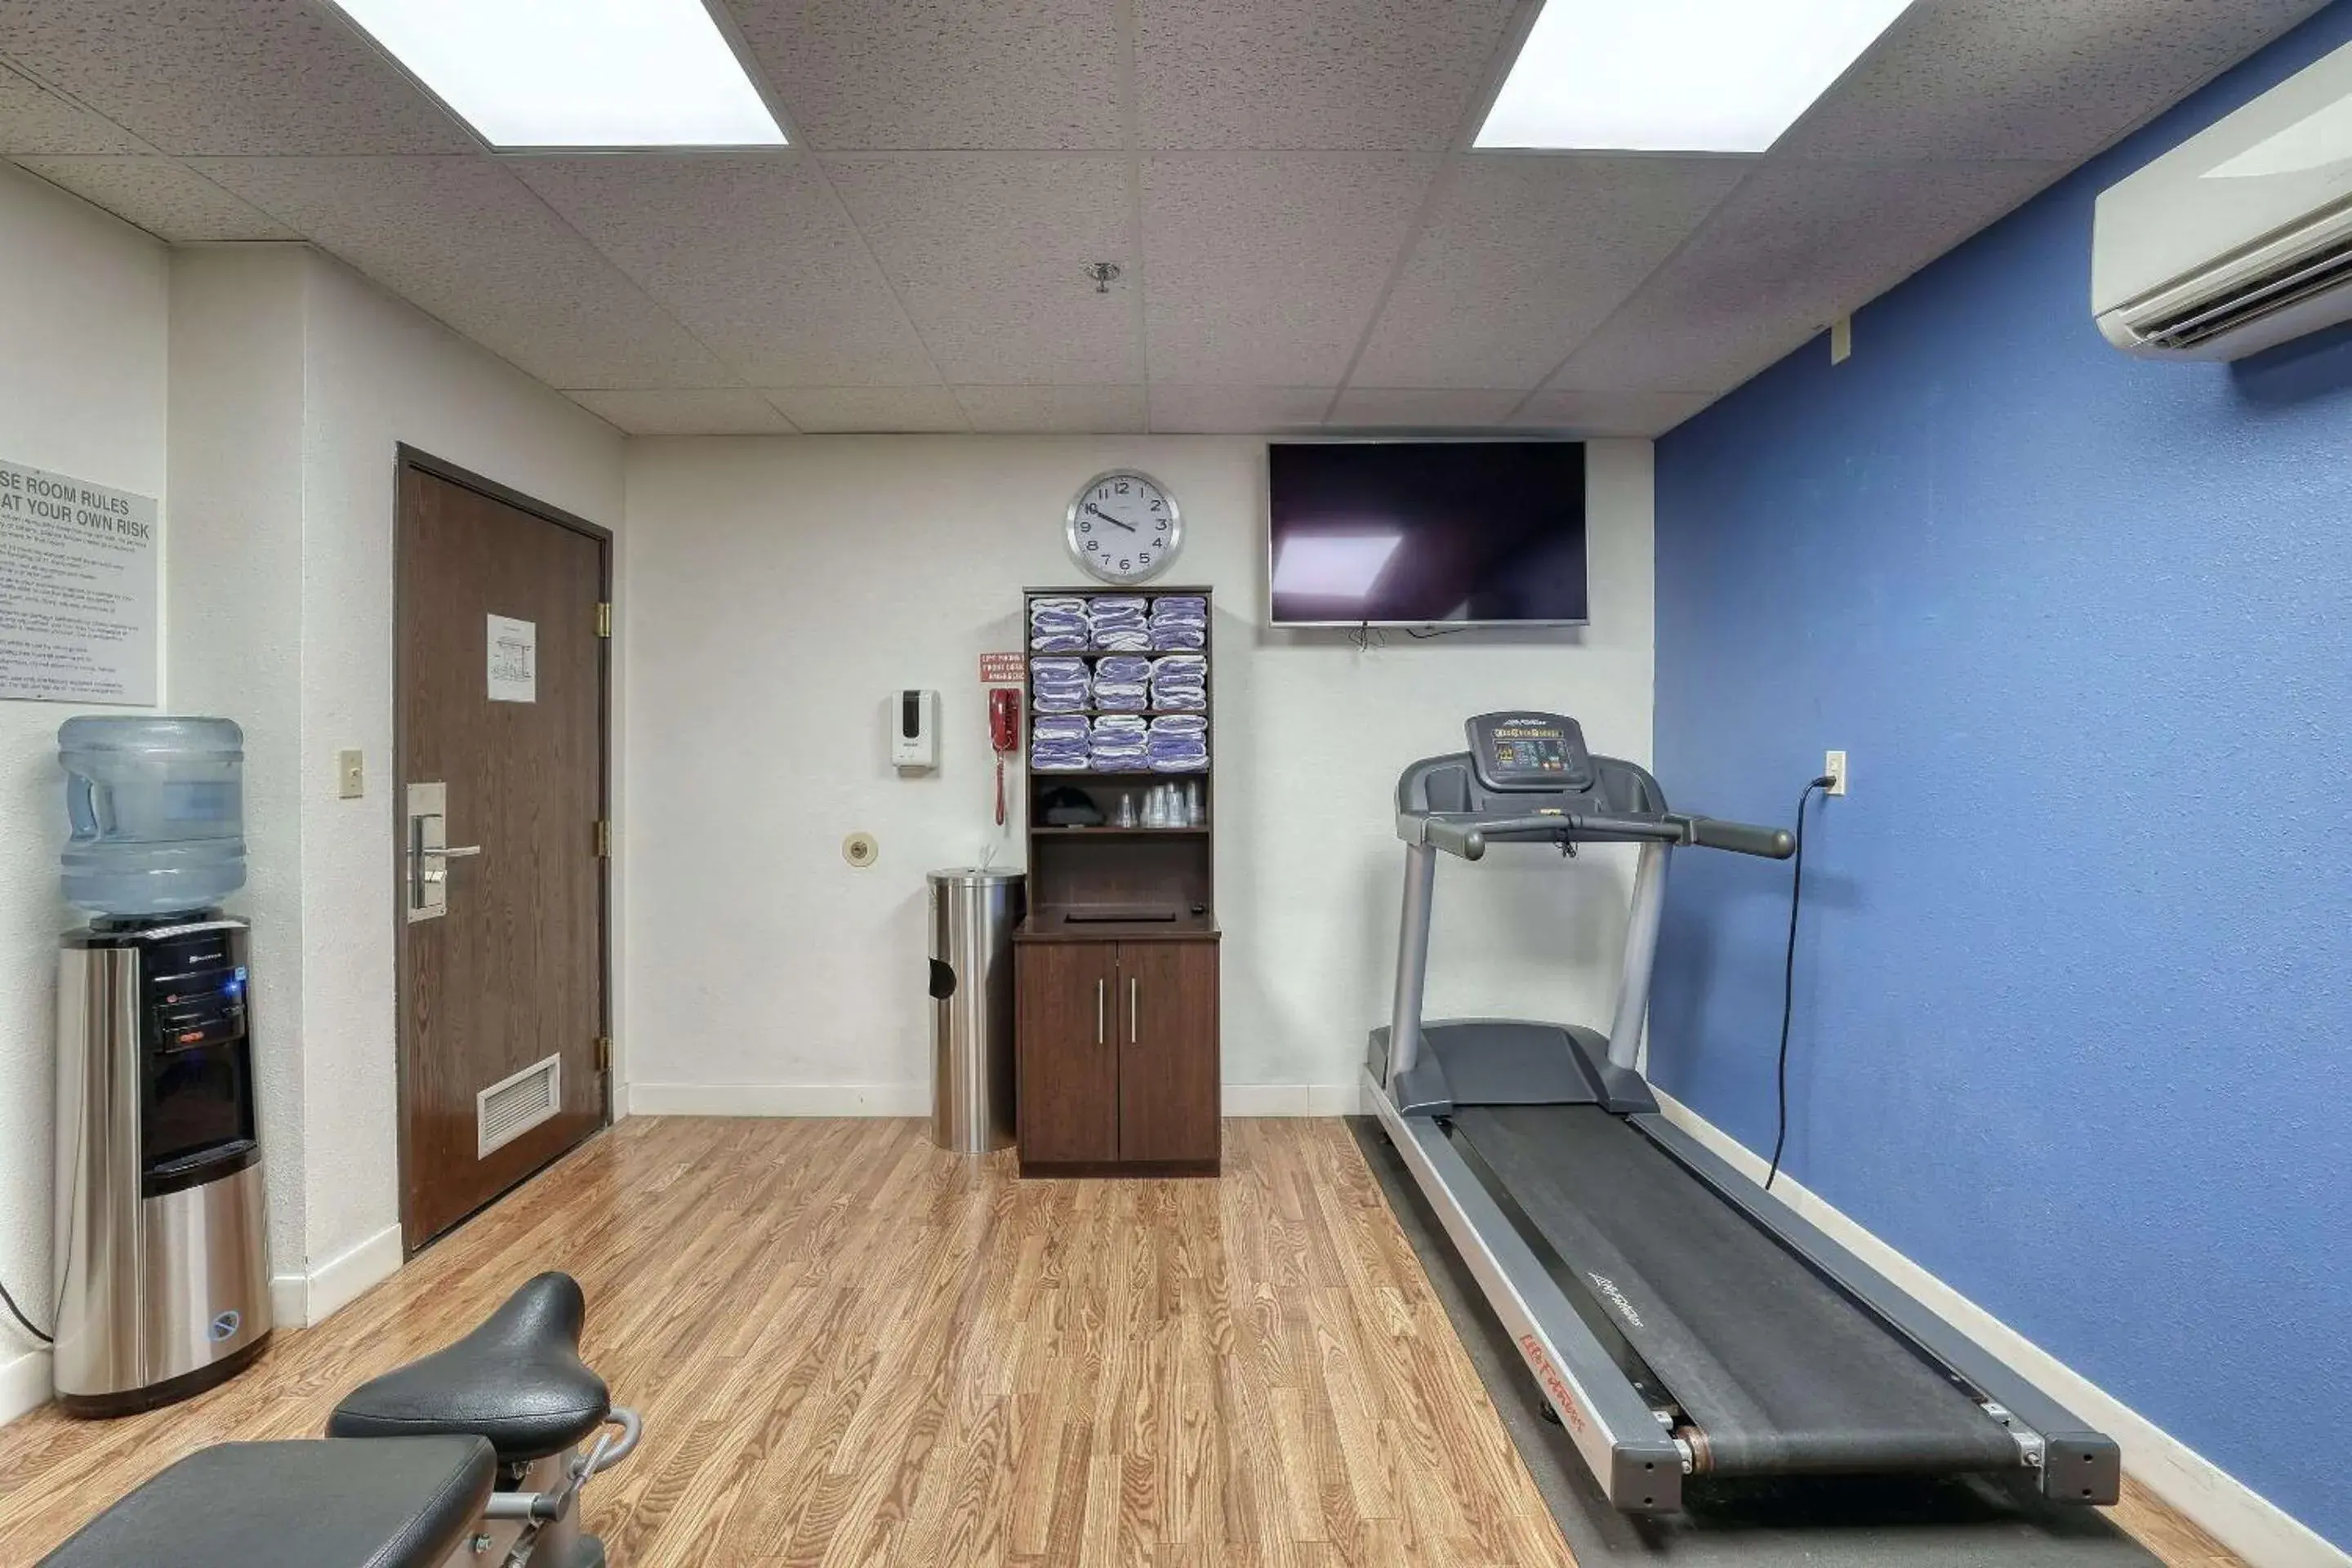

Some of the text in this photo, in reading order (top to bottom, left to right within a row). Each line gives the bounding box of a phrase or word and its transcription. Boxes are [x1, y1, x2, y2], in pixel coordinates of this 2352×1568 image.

[1098, 488, 1108, 500] 11
[1115, 483, 1129, 494] 12
[1140, 488, 1144, 498] 1
[26, 476, 76, 503] ROOM
[81, 490, 129, 515] RULES
[1085, 503, 1098, 514] 10
[1151, 500, 1161, 512] 2
[1, 493, 23, 511] AT
[27, 498, 72, 523] YOUR
[77, 510, 113, 531] OWN
[117, 519, 150, 540] RISK
[1080, 521, 1092, 532] 9
[1155, 519, 1168, 531] 3
[1086, 541, 1098, 551] 8
[1152, 537, 1162, 548] 4
[1101, 555, 1111, 565] 7
[1139, 553, 1151, 564] 5
[1119, 559, 1130, 570] 6
